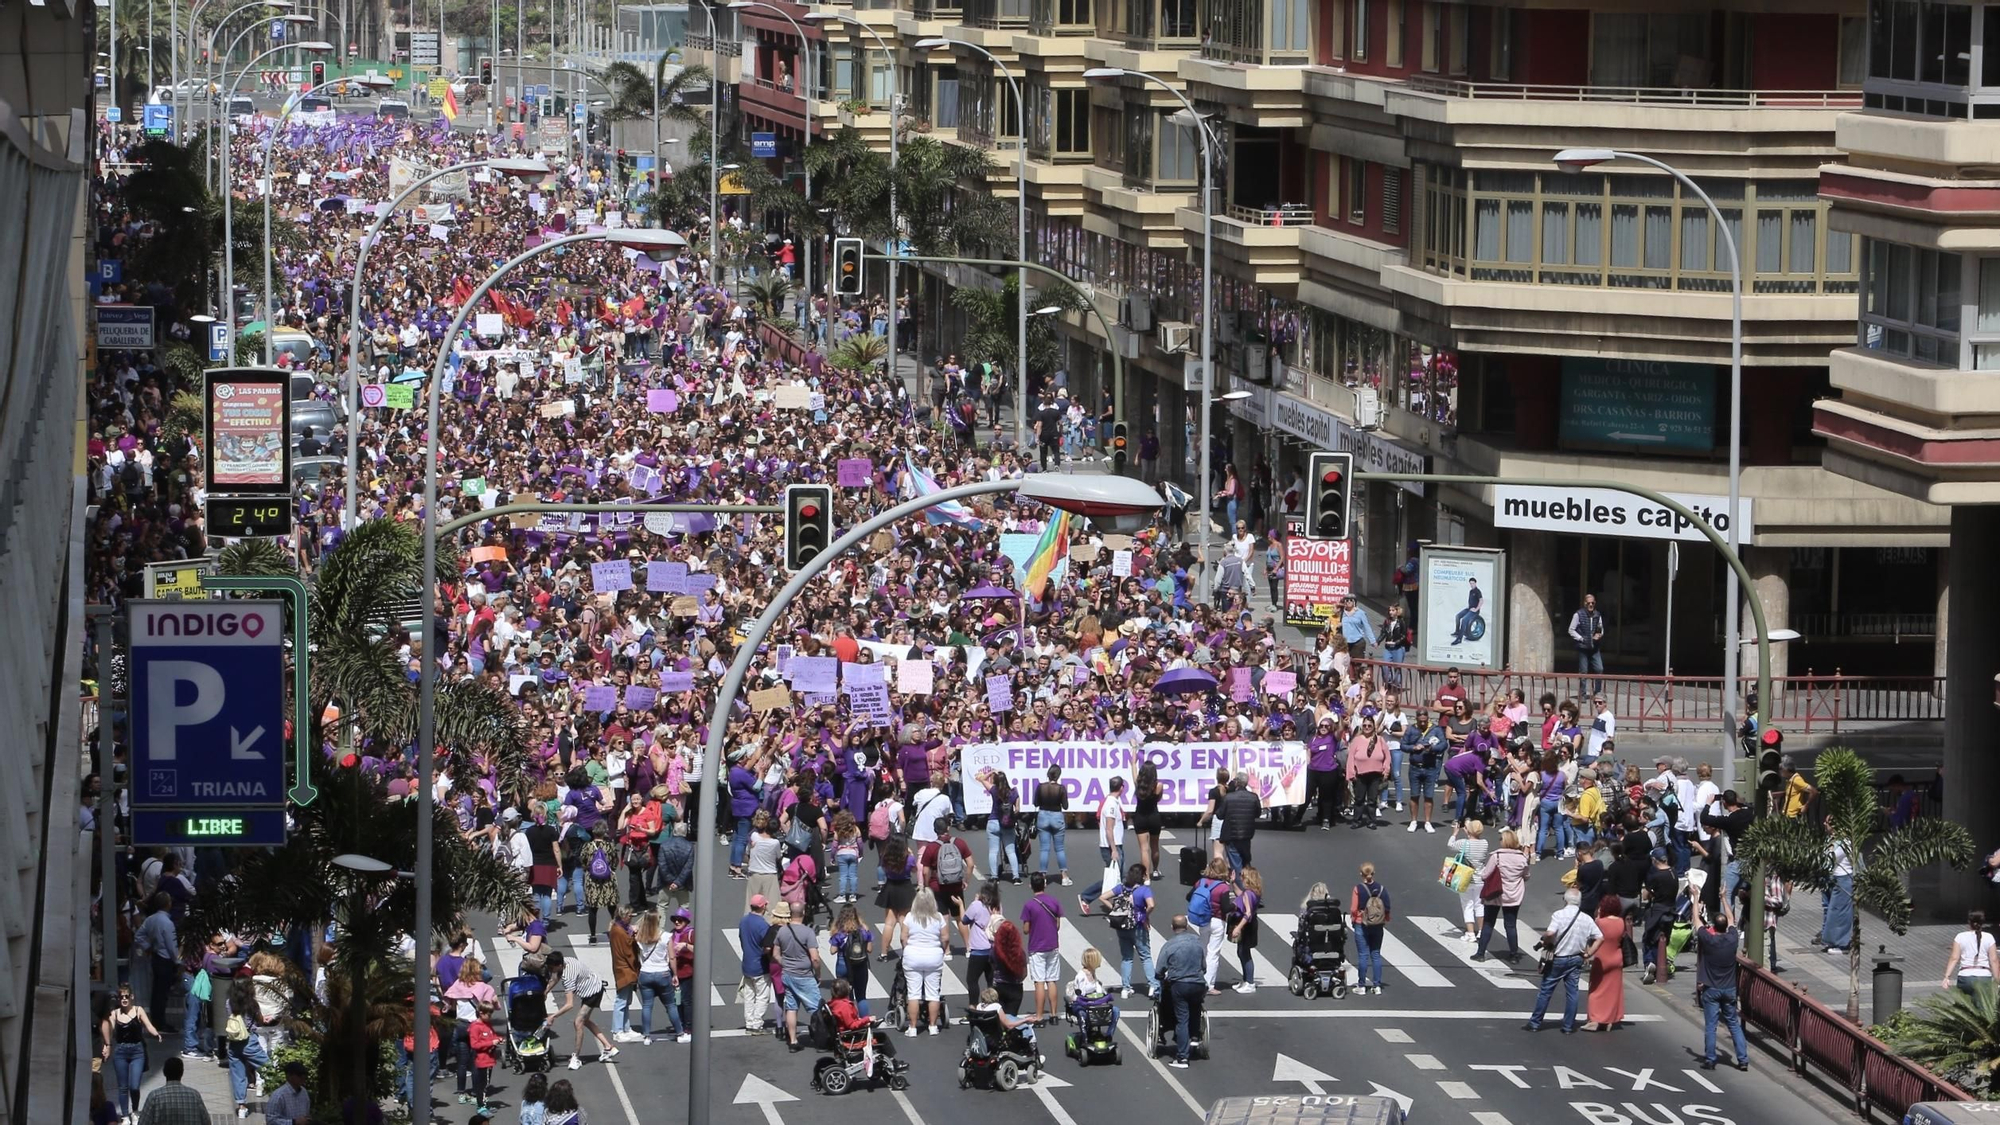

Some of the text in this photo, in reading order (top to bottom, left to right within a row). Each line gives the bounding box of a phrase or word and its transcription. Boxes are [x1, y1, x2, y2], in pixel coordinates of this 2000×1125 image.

[103, 264, 114, 279] B
[100, 326, 149, 336] PELUQUERIA DE
[217, 328, 227, 341] P
[104, 336, 144, 345] CABALLEROS
[1605, 360, 1670, 375] CLINICA
[1579, 374, 1621, 386] MEDICO
[1629, 377, 1698, 391] QUIRURGICA
[1574, 389, 1626, 400] GARGANTA
[1635, 391, 1663, 402] NARIZ
[1671, 394, 1702, 404] OIDOS
[1573, 404, 1595, 414] DRS.
[1598, 404, 1646, 418] CASAÑAS
[1655, 409, 1702, 421] BARRIOS
[230, 418, 272, 426] EFECTIVO
[1277, 402, 1330, 444] muebles capitol
[1339, 431, 1383, 468] muebles
[1504, 497, 1730, 534] muebles capito
[1287, 538, 1350, 562] ESTOPA
[197, 568, 206, 576] 23
[1287, 559, 1338, 575] LOQUILLO
[1321, 585, 1349, 595] HUECCO
[147, 612, 265, 639] INDIGO
[147, 660, 226, 760] P
[973, 755, 1000, 765] RED
[1008, 748, 1285, 770] FEMINISMOS EN PIE
[152, 772, 165, 781] 24
[161, 784, 174, 793] 24
[191, 781, 267, 796] TRIANA
[187, 818, 243, 836] LIBRE
[1468, 1064, 1725, 1094] TAXI
[1568, 1101, 1737, 1125] BUS
